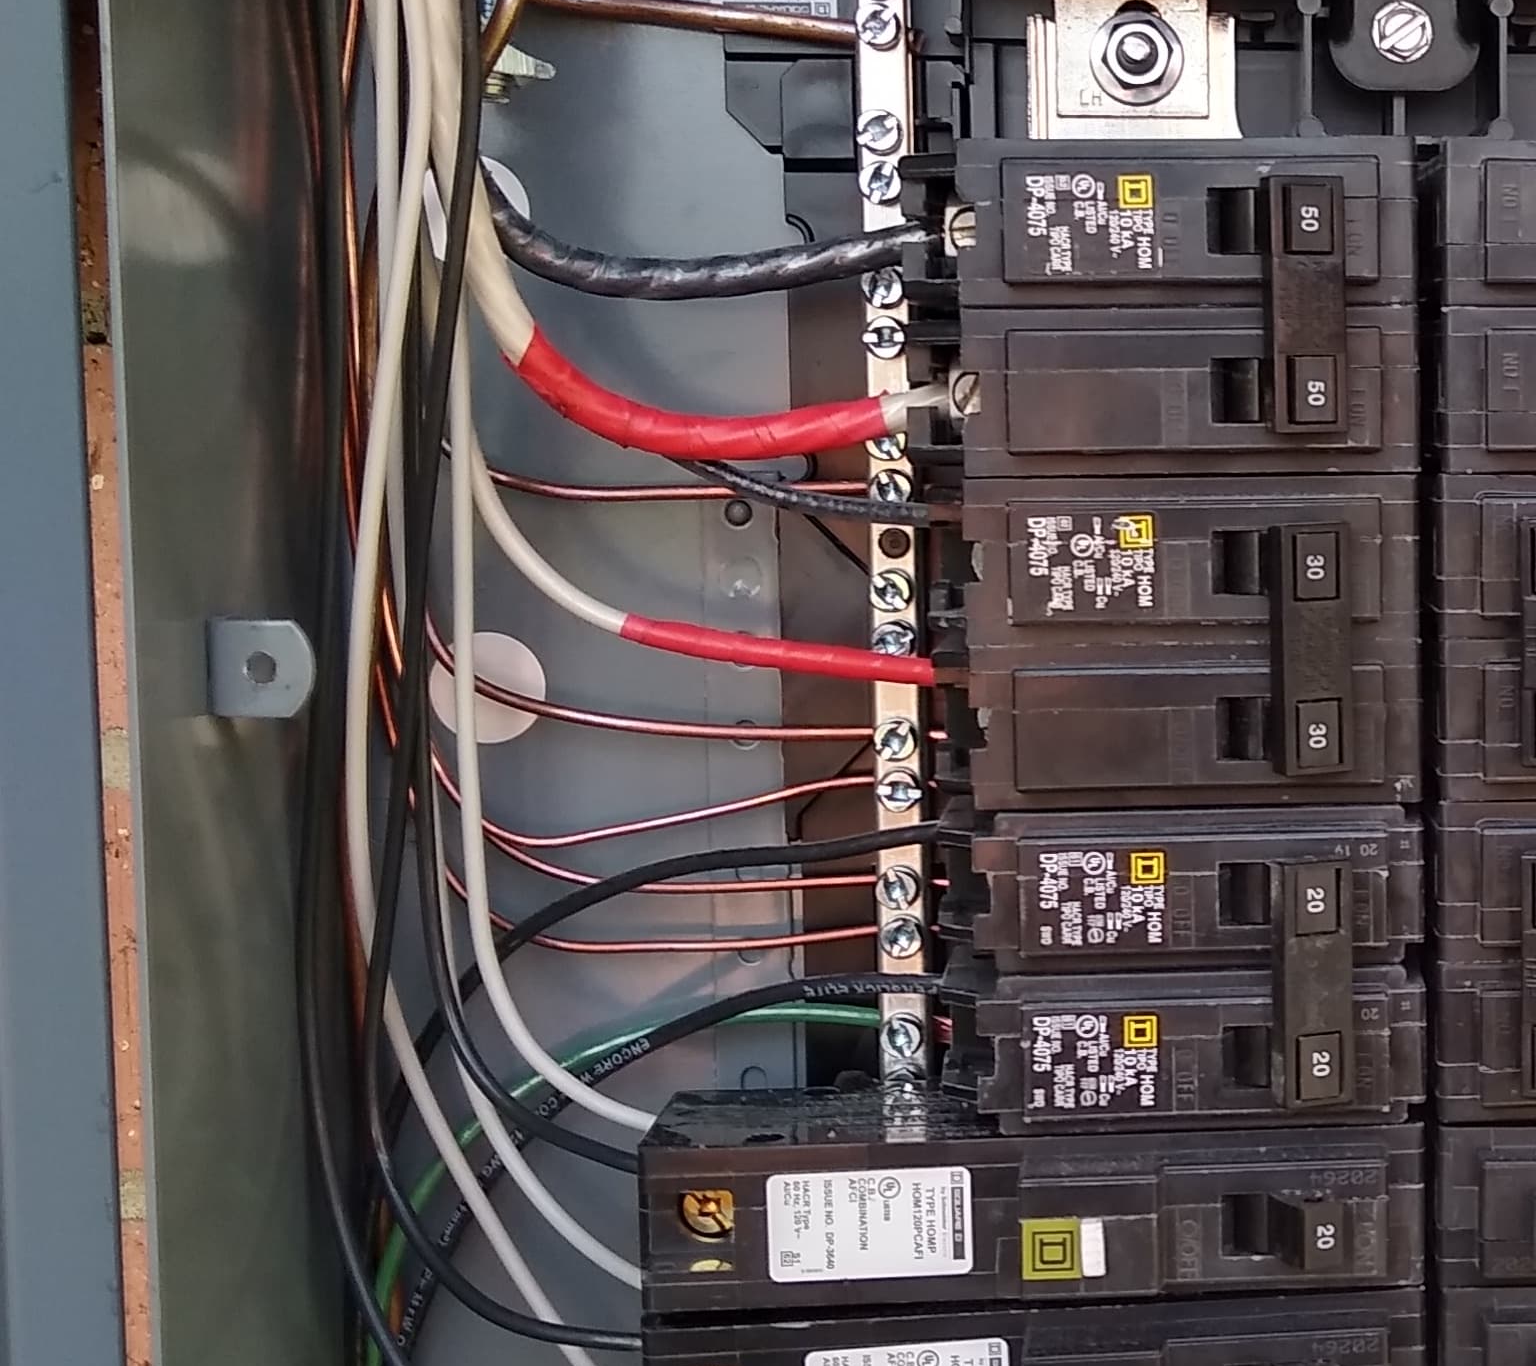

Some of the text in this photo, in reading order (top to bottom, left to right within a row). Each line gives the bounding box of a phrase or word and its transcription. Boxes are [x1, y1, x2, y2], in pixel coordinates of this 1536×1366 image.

[1025, 176, 1047, 236] DP-4075
[1120, 211, 1133, 227] 10
[1300, 205, 1319, 232] 50
[1137, 210, 1155, 269] TYPE HOM
[1307, 380, 1326, 407] 50
[1027, 517, 1049, 576] DP-4075
[1121, 550, 1134, 566] 10
[1137, 549, 1155, 607] TYPE HOM
[1306, 555, 1325, 580] 30
[1308, 723, 1327, 749] 30
[1360, 843, 1378, 856] 20
[1040, 854, 1058, 909] DP-4075
[1131, 886, 1144, 902] 10
[1147, 885, 1165, 943] TYPE HOM
[1306, 888, 1325, 913] 20
[1360, 1008, 1380, 1020] 20
[1032, 1017, 1052, 1072] DP-4075
[1124, 1049, 1137, 1066] 10
[1140, 1048, 1158, 1106] TYPE HOM
[1312, 1052, 1330, 1077] 20
[824, 1180, 833, 1208] ISSUE
[848, 1178, 858, 1203] AFCI
[858, 1178, 869, 1251] COMBINATION
[912, 1183, 924, 1260] HOM120PCAFI
[925, 1188, 937, 1254] TYPE HOMP
[1316, 1224, 1335, 1249] 20
[825, 1232, 835, 1270] DP-3640
